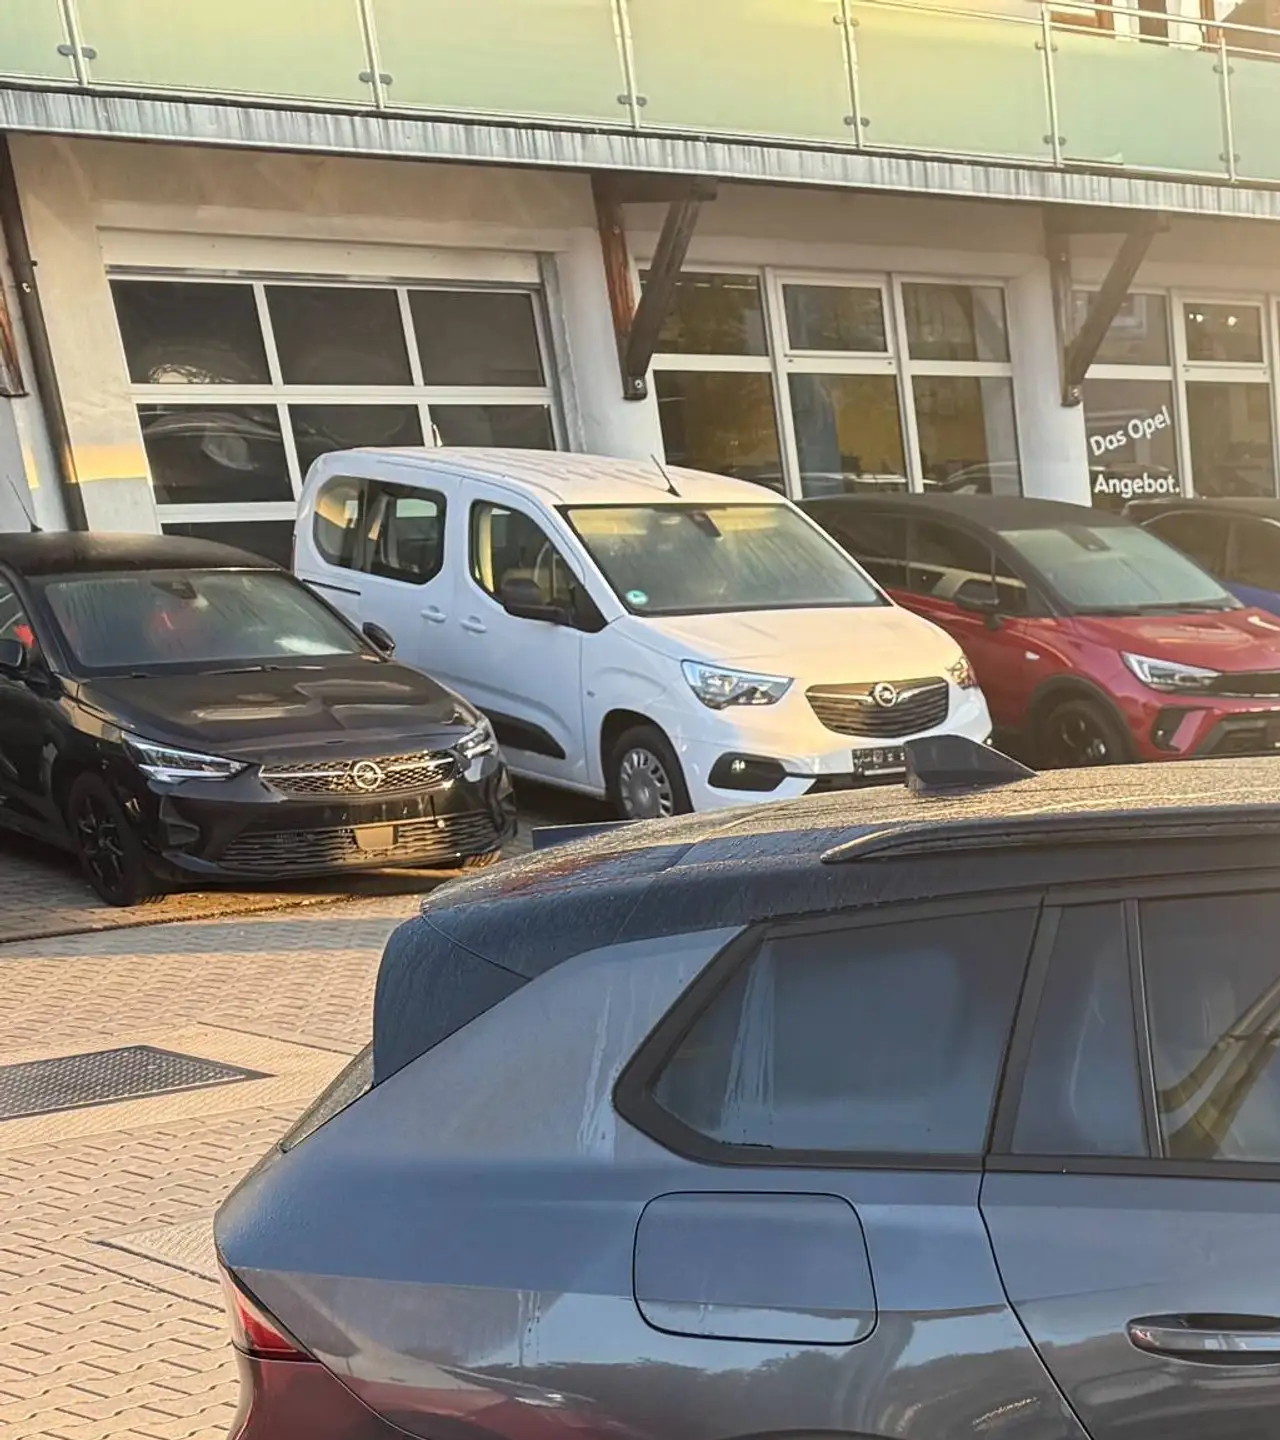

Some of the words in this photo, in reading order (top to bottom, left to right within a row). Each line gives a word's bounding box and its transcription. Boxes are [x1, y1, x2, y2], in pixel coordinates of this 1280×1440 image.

[1089, 430, 1128, 456] Das
[1127, 404, 1171, 440] Opel
[1094, 472, 1181, 499] Angebot.
